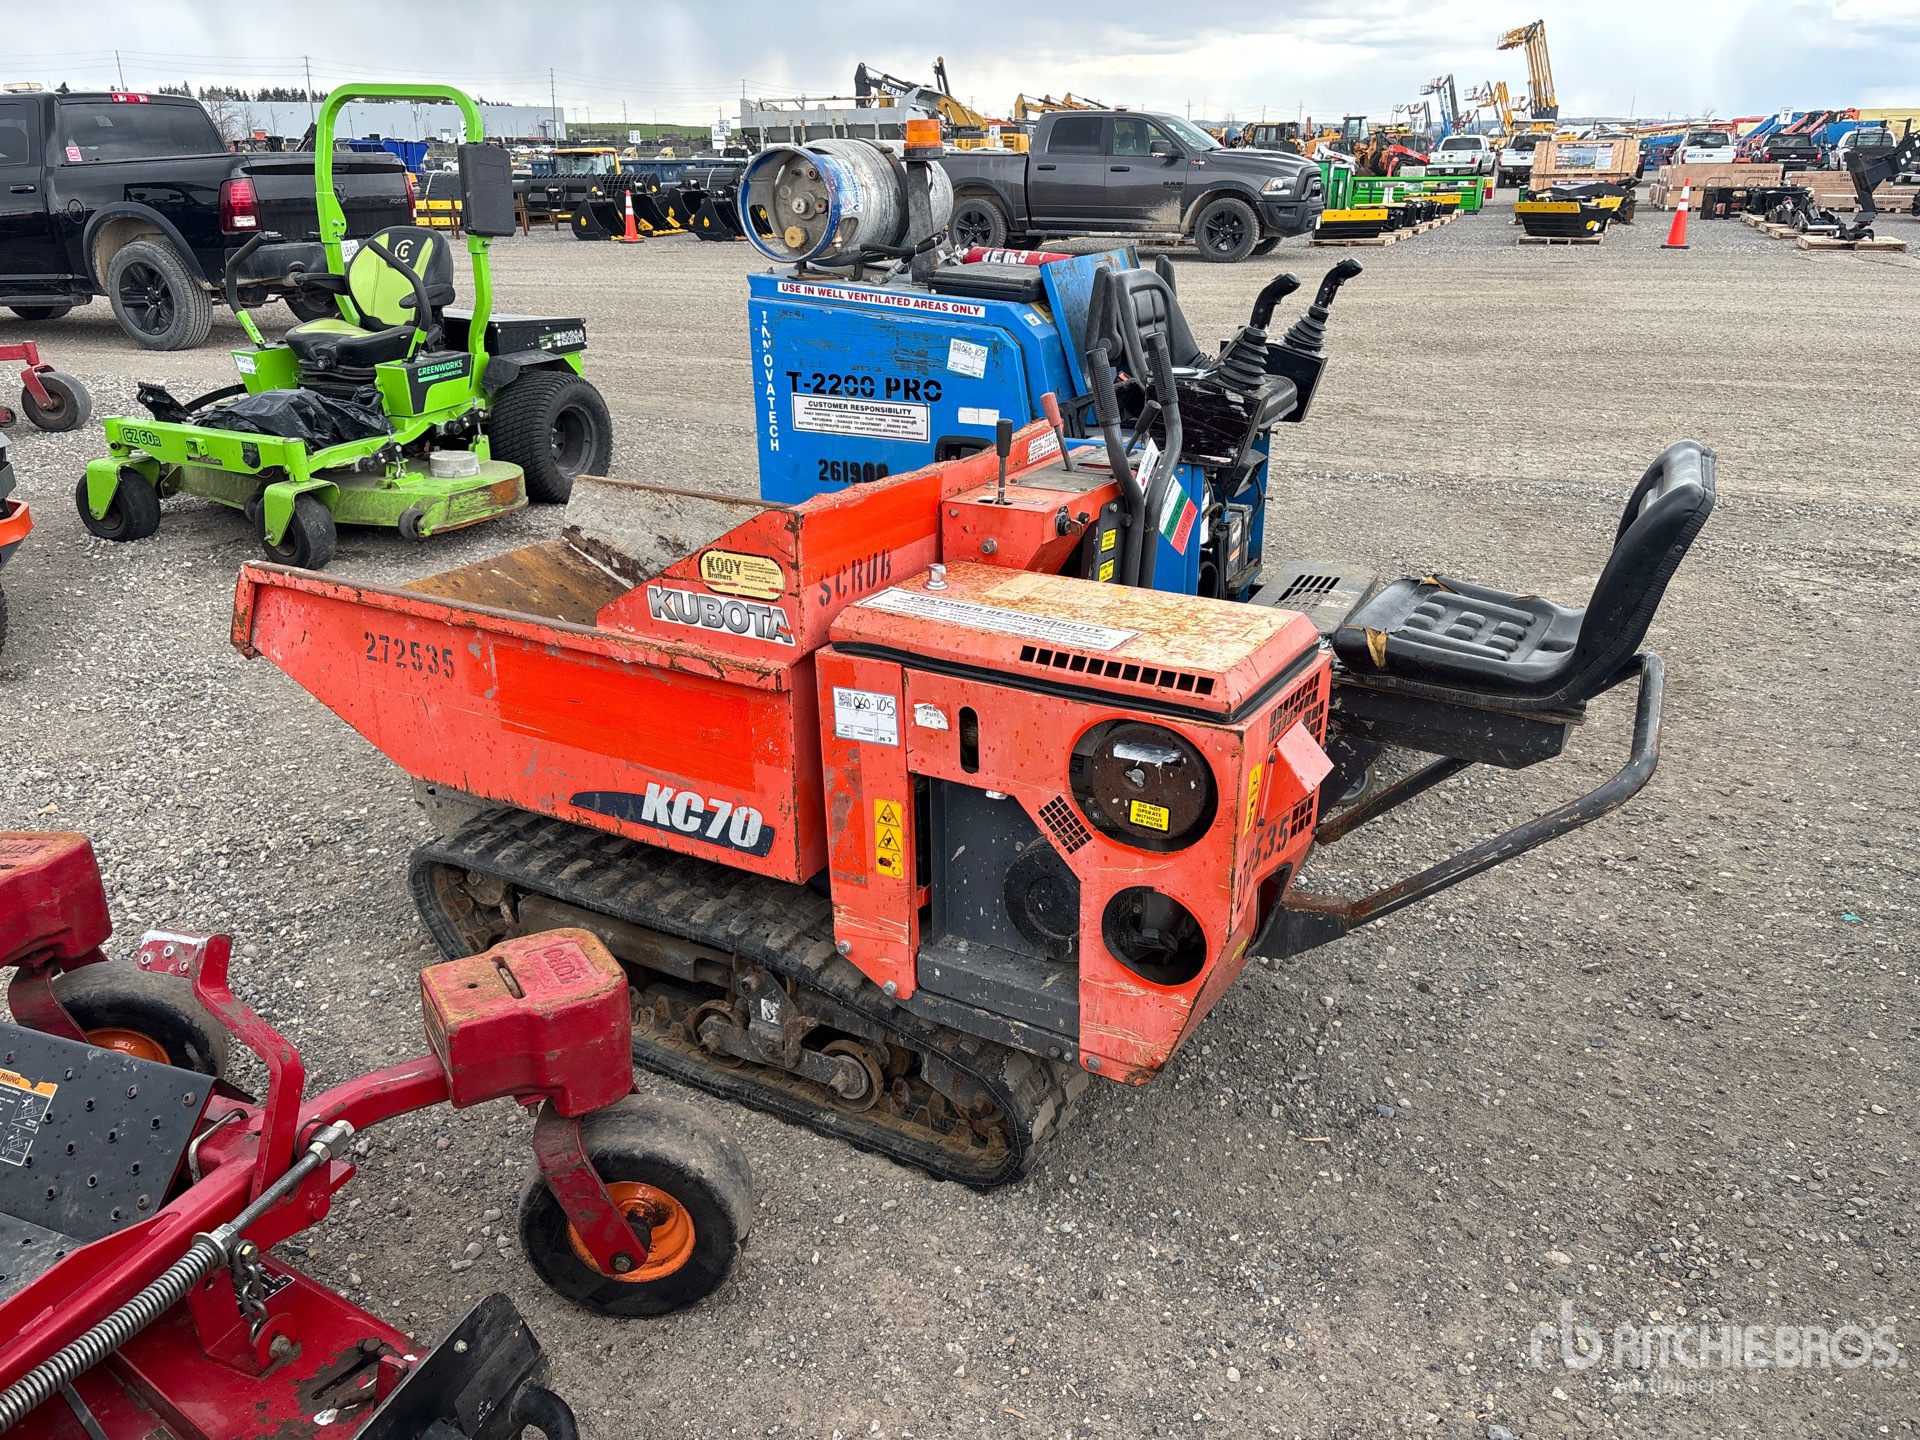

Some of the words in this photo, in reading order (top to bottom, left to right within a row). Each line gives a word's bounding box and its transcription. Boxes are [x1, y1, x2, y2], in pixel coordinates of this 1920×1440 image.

[782, 284, 801, 293] USE
[804, 286, 815, 295] IN
[818, 287, 844, 299] WELL
[847, 291, 910, 307] VENTILATED
[914, 300, 948, 312] AREAS
[952, 304, 980, 315] ONLY
[418, 359, 463, 376] GREENWORKS
[762, 310, 779, 452] INNOVATECH
[786, 371, 875, 398] T-2200
[885, 377, 943, 402] PRO
[808, 401, 849, 410] CUSTOMER
[850, 402, 912, 415] RESPONSIBILITY
[123, 428, 139, 443] CZ
[1166, 516, 1176, 536] READY
[706, 556, 741, 576] KOOY
[708, 572, 732, 581] Brothers
[819, 548, 892, 607] SCRUB
[649, 588, 794, 644] KUBOTA
[910, 596, 984, 611] CUSTOMER
[986, 610, 1104, 632] RESPONSIBILITY
[364, 632, 454, 678] 272535
[642, 782, 763, 848] KC70
[1136, 813, 1163, 823] WITHOUT
[1137, 808, 1162, 818] OPERATE
[542, 948, 582, 984] TORO
